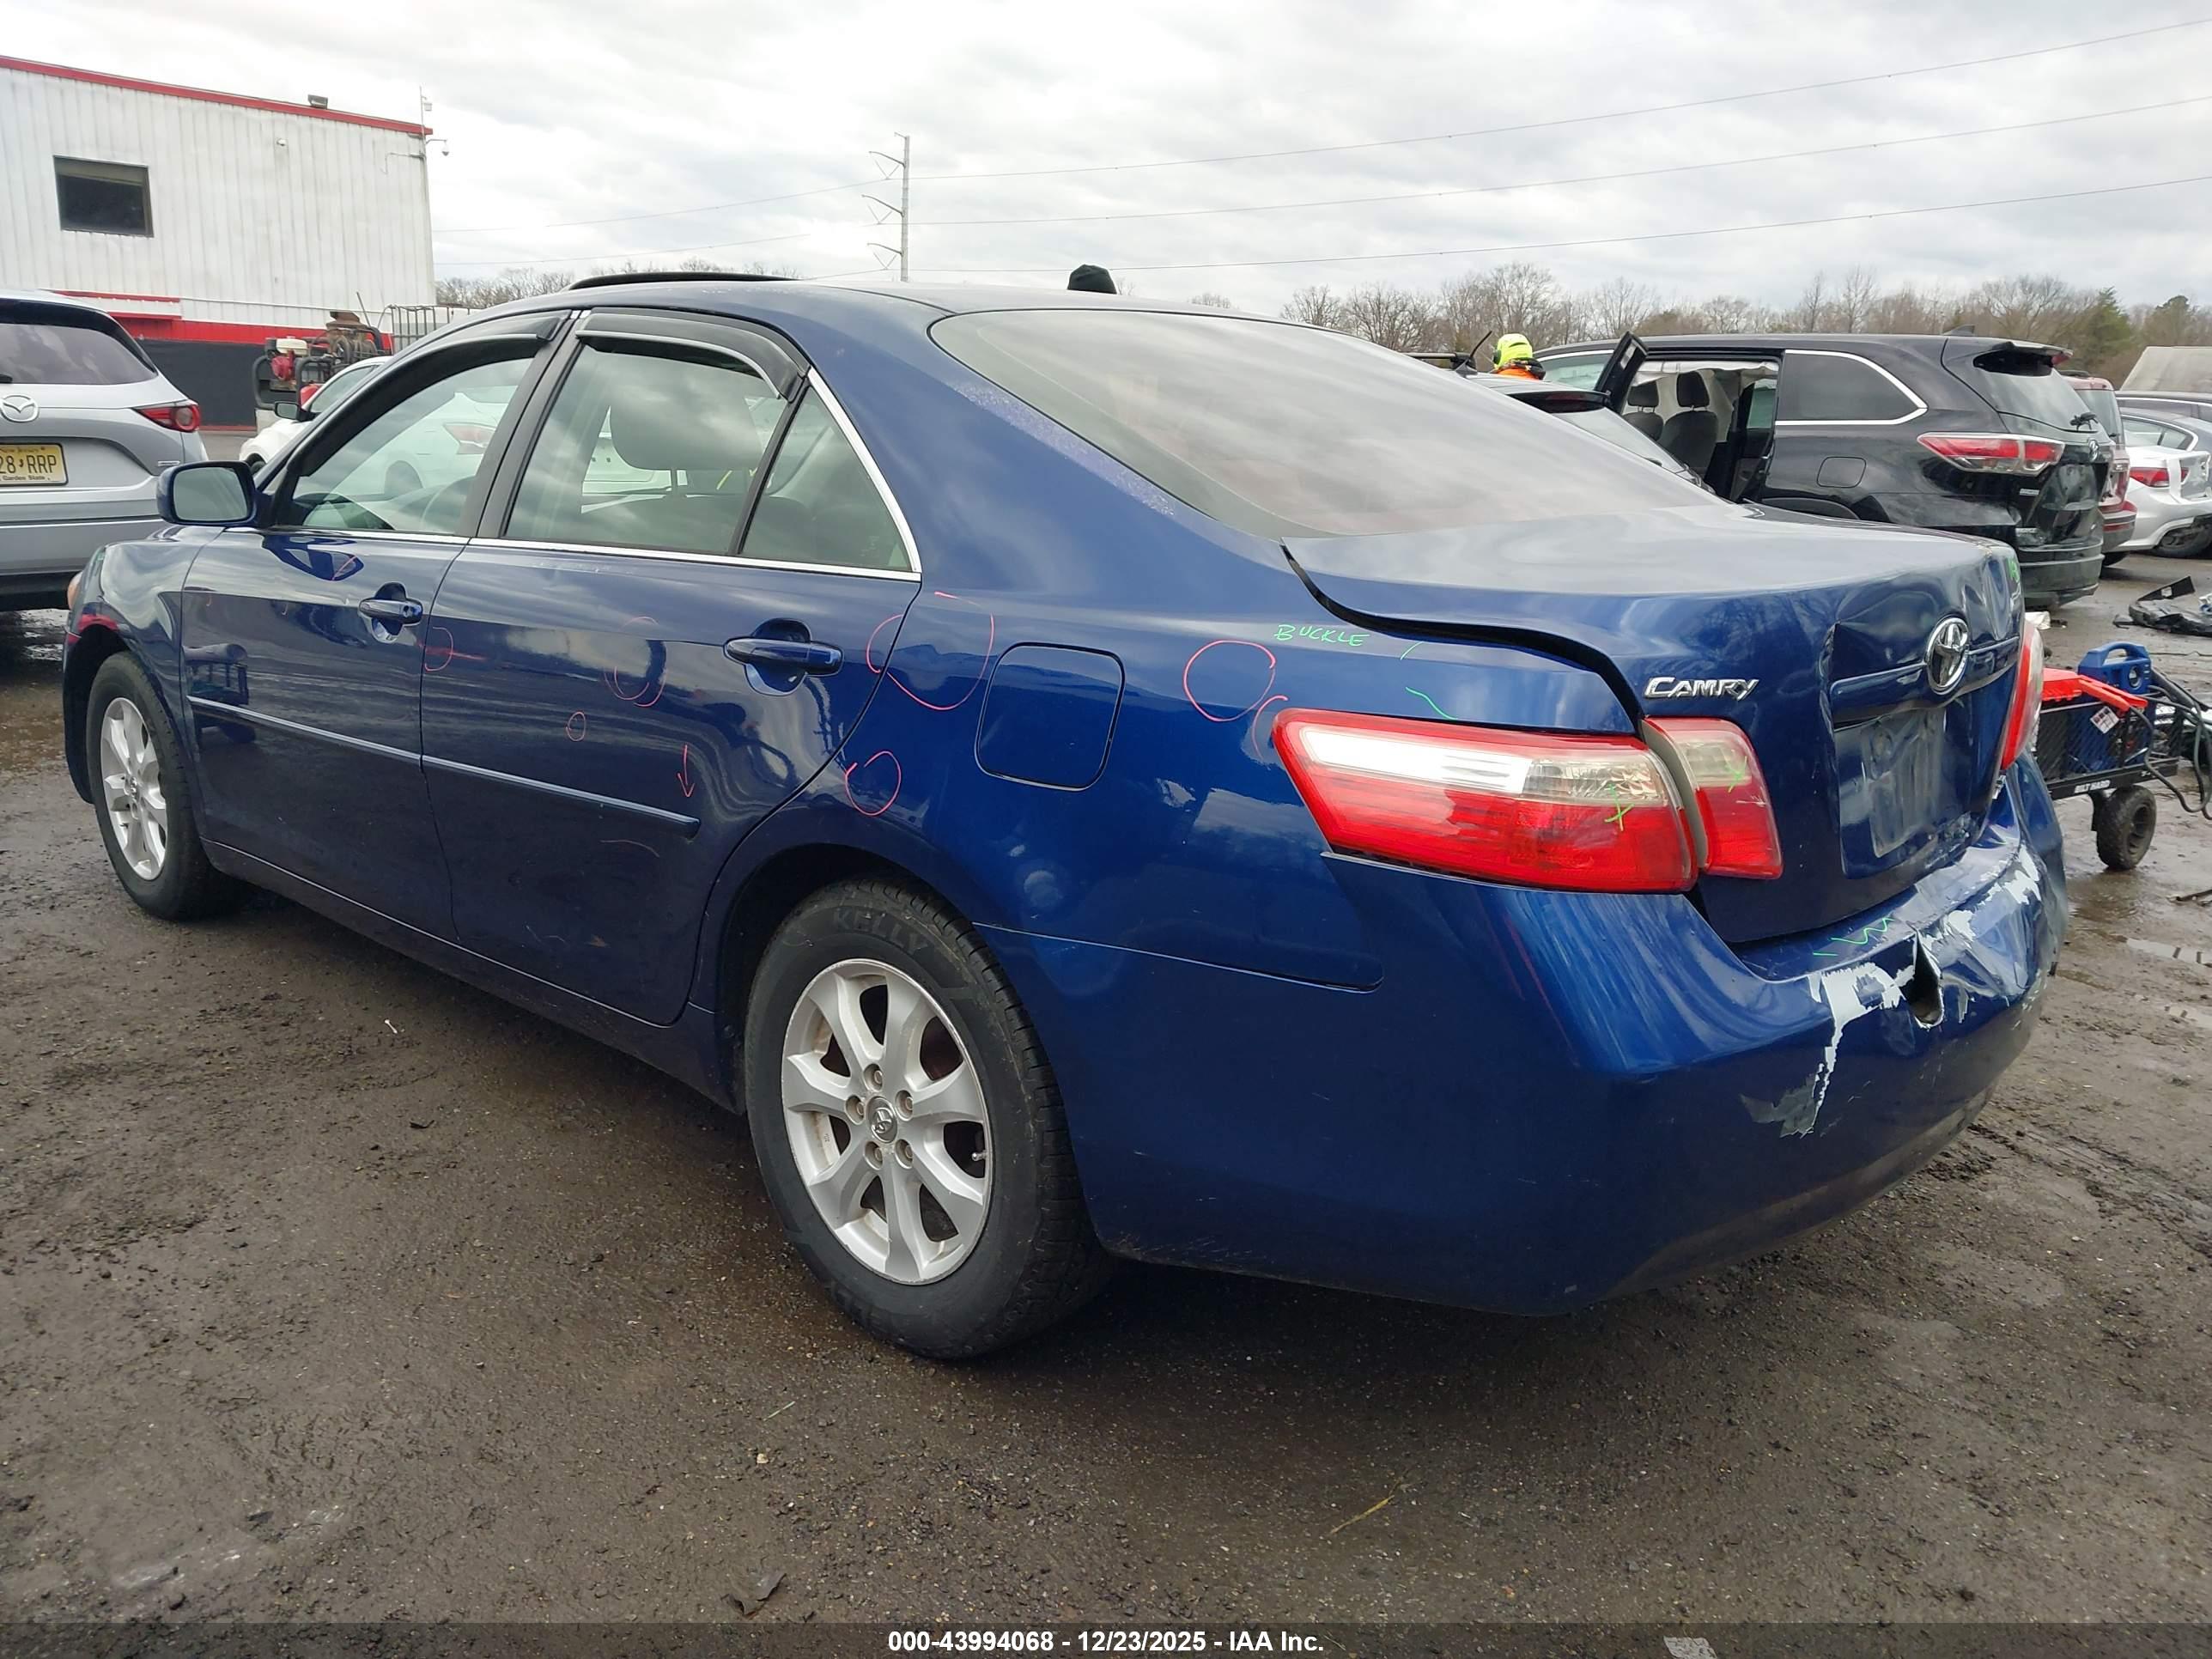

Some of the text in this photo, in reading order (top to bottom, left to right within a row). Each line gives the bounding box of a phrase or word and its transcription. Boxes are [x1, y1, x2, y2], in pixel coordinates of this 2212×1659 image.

[1273, 624, 1370, 647] BUCKLE
[1644, 676, 1759, 702] CAMRY
[832, 907, 929, 955] KELLY
